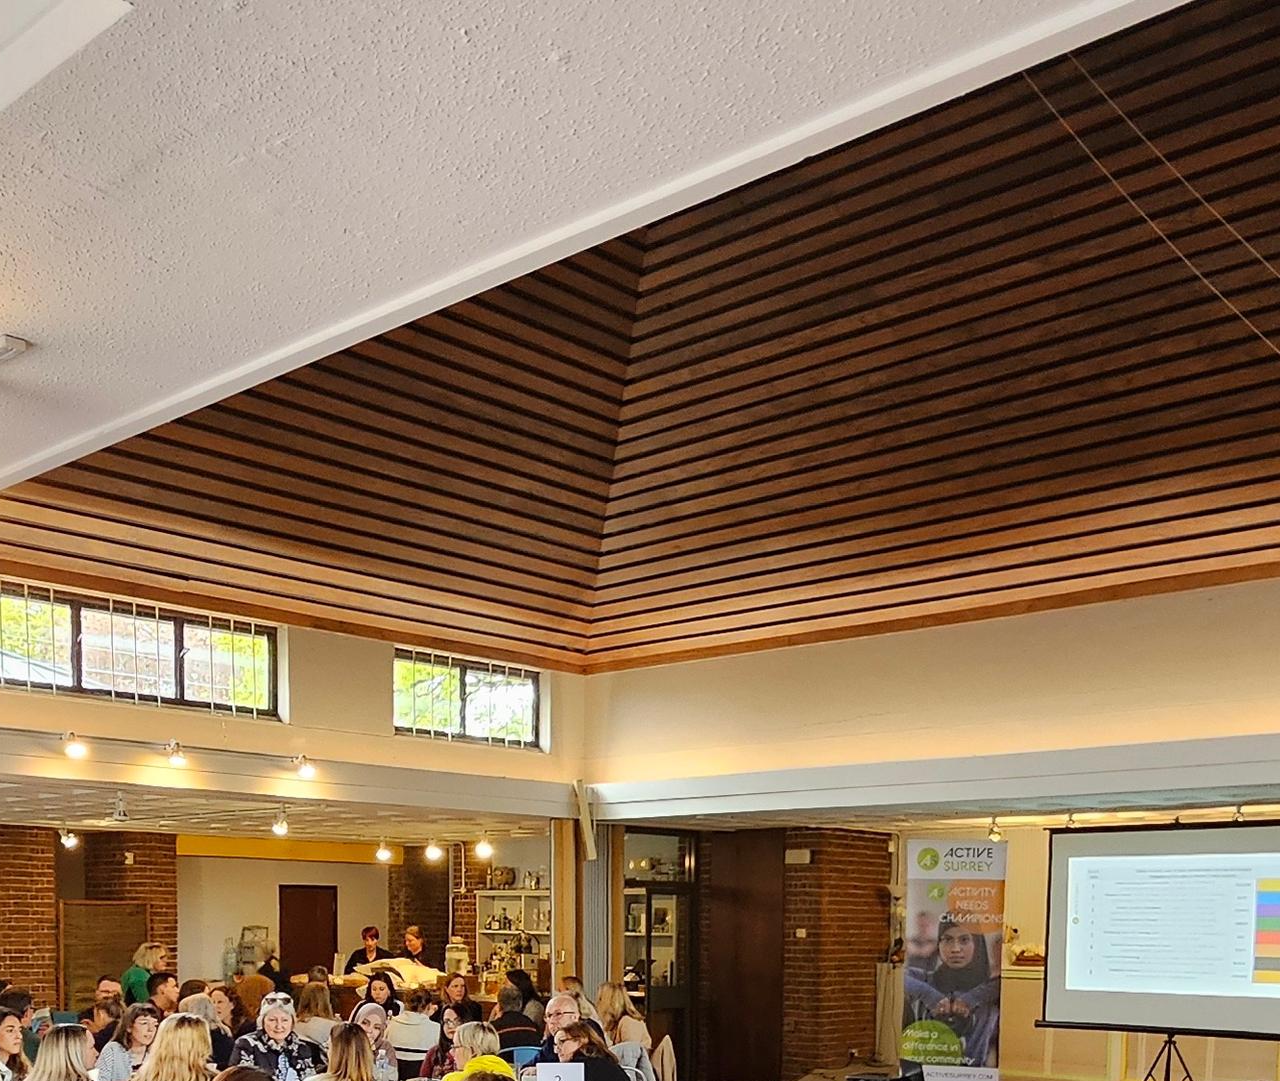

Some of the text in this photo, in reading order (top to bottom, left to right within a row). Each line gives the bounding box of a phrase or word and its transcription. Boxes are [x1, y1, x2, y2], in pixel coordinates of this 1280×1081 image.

[943, 847, 994, 859] ACTIVE
[943, 860, 993, 872] SURREY
[949, 887, 997, 897] ACTIVITY
[956, 900, 989, 910] NEEDS
[902, 1041, 948, 1052] difference
[925, 1055, 976, 1066] community
